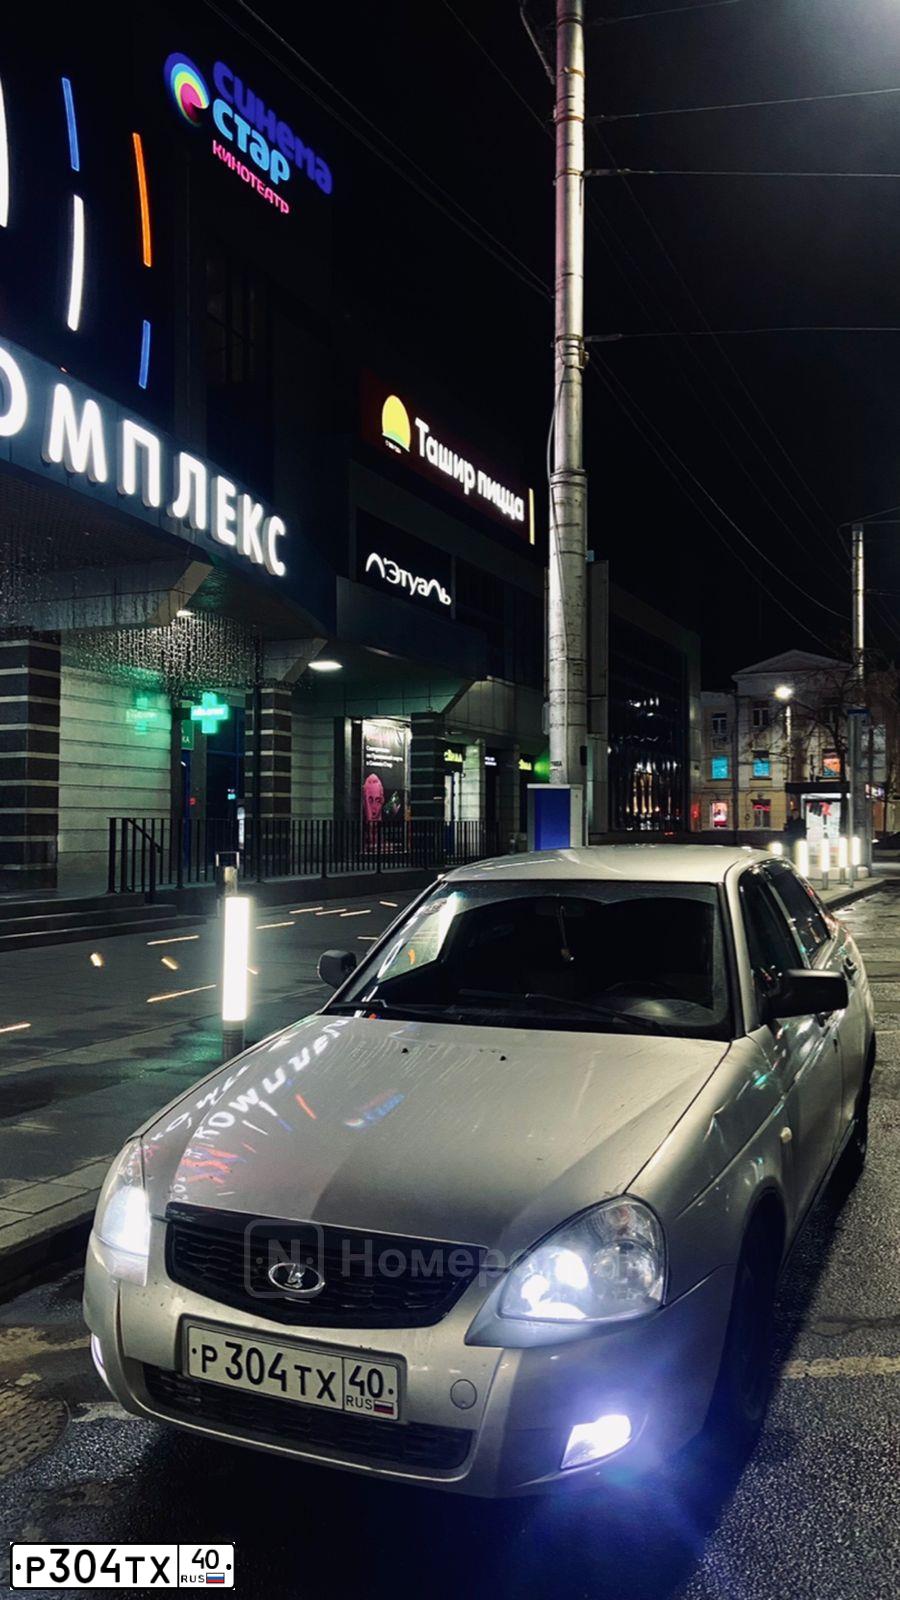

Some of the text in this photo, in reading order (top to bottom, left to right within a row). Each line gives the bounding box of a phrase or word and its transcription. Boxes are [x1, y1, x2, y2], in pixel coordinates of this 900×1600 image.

[212, 139, 290, 214] КИНОТЕАТР
[415, 416, 525, 522] Ташир пицца
[345, 1394, 374, 1412] RUS
